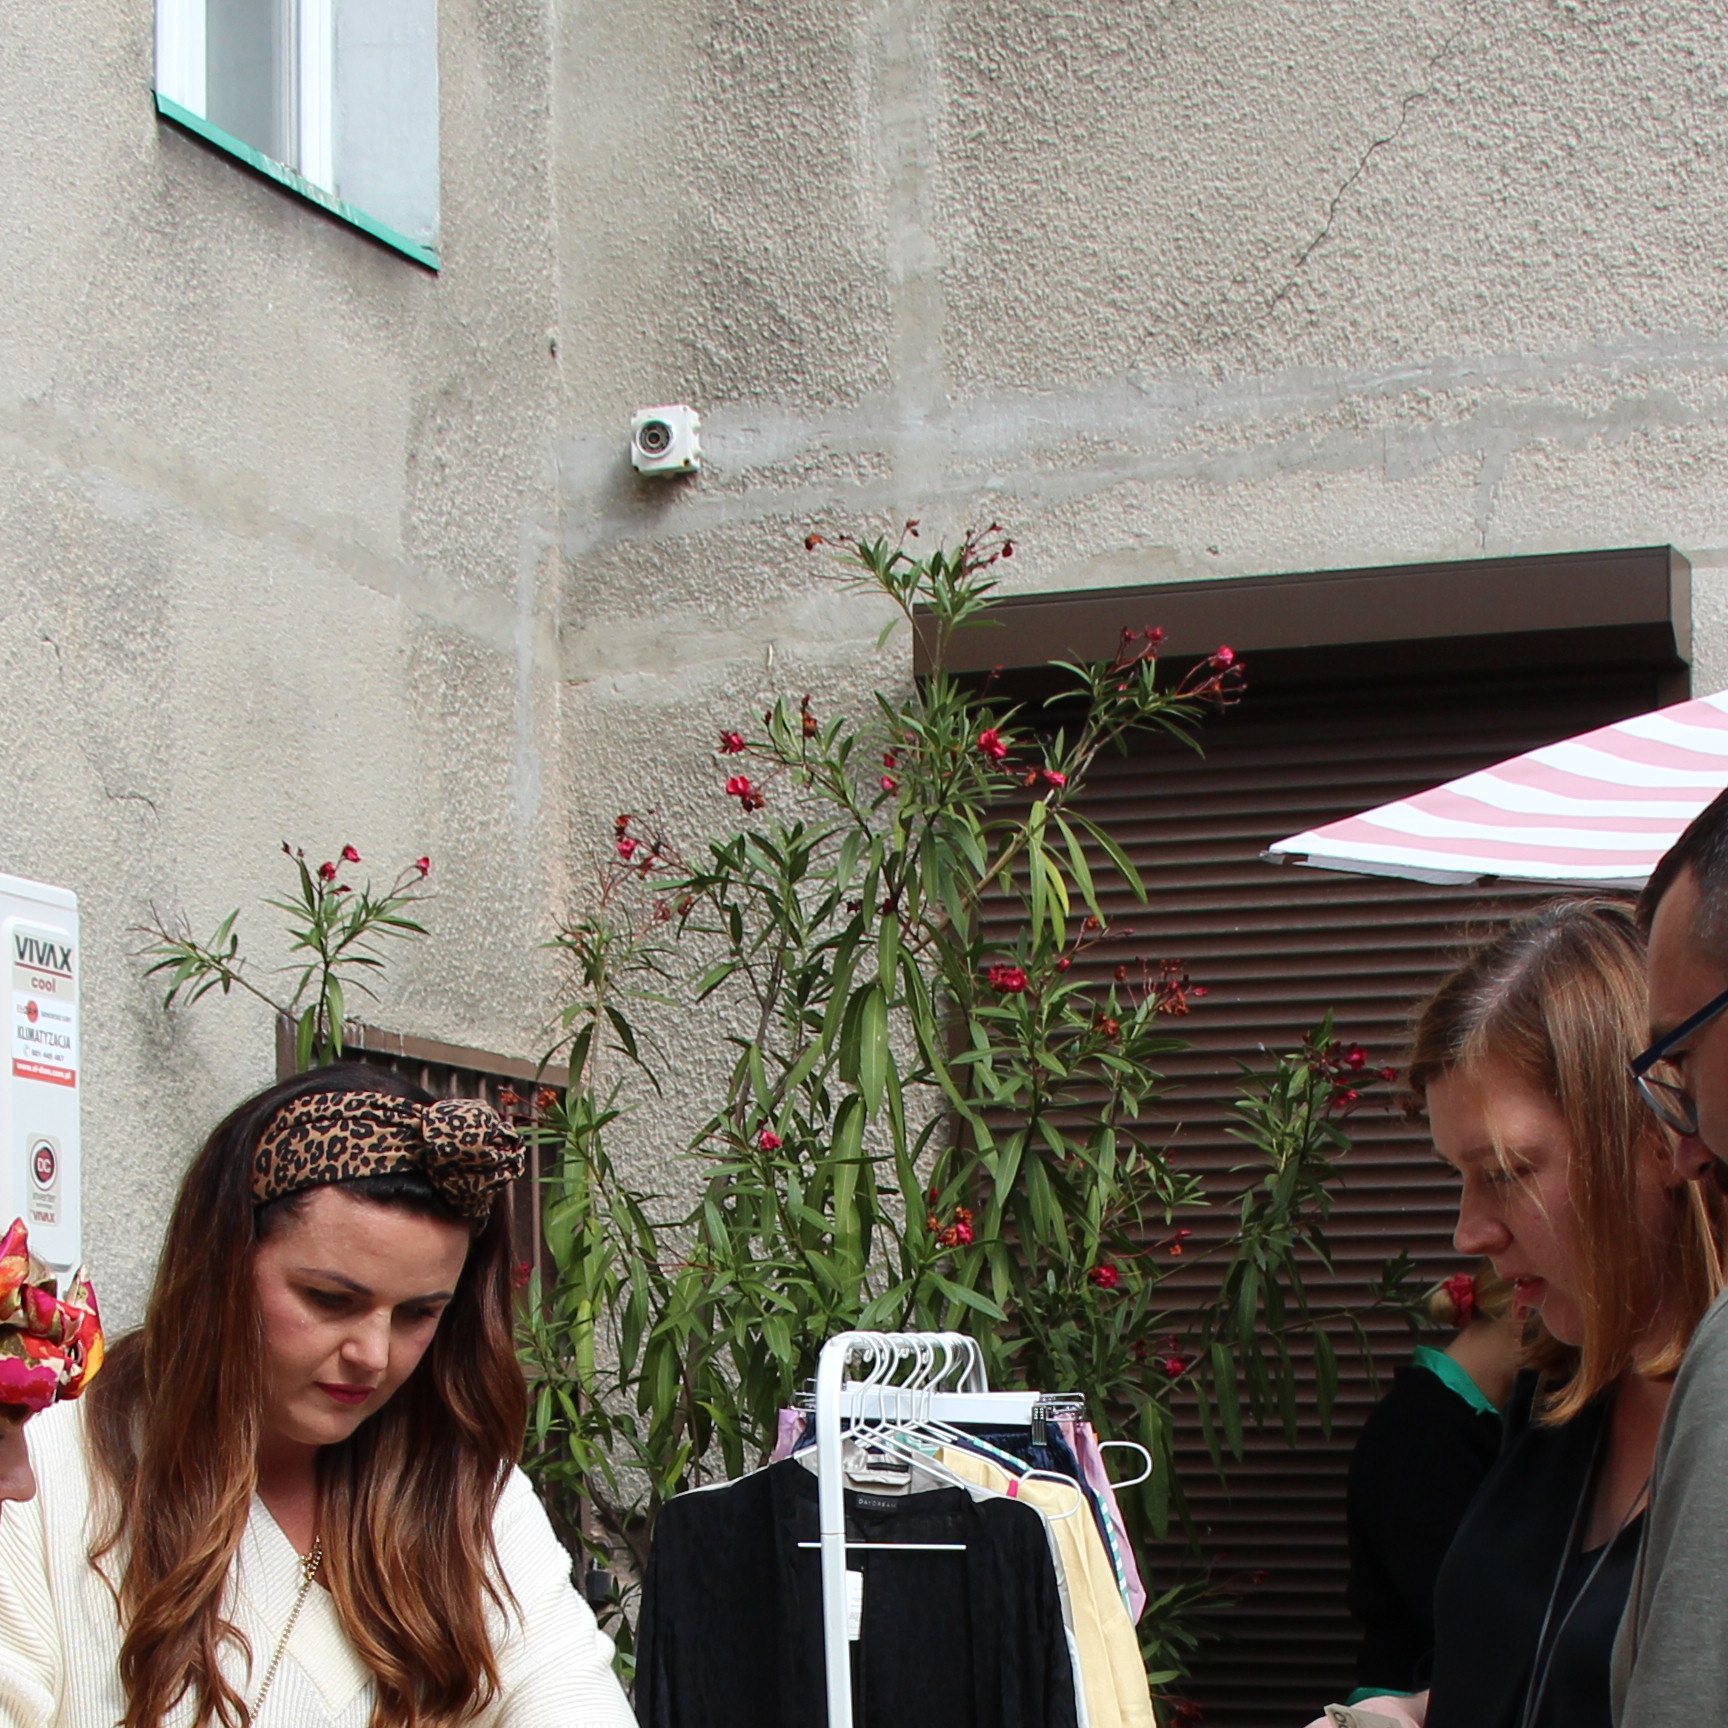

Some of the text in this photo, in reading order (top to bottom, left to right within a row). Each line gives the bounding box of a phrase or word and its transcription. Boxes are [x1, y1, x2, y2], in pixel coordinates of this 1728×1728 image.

[15, 934, 72, 973] VIVAX
[31, 977, 56, 993] cool
[37, 1157, 51, 1173] DC
[30, 1209, 55, 1223] VIVAX
